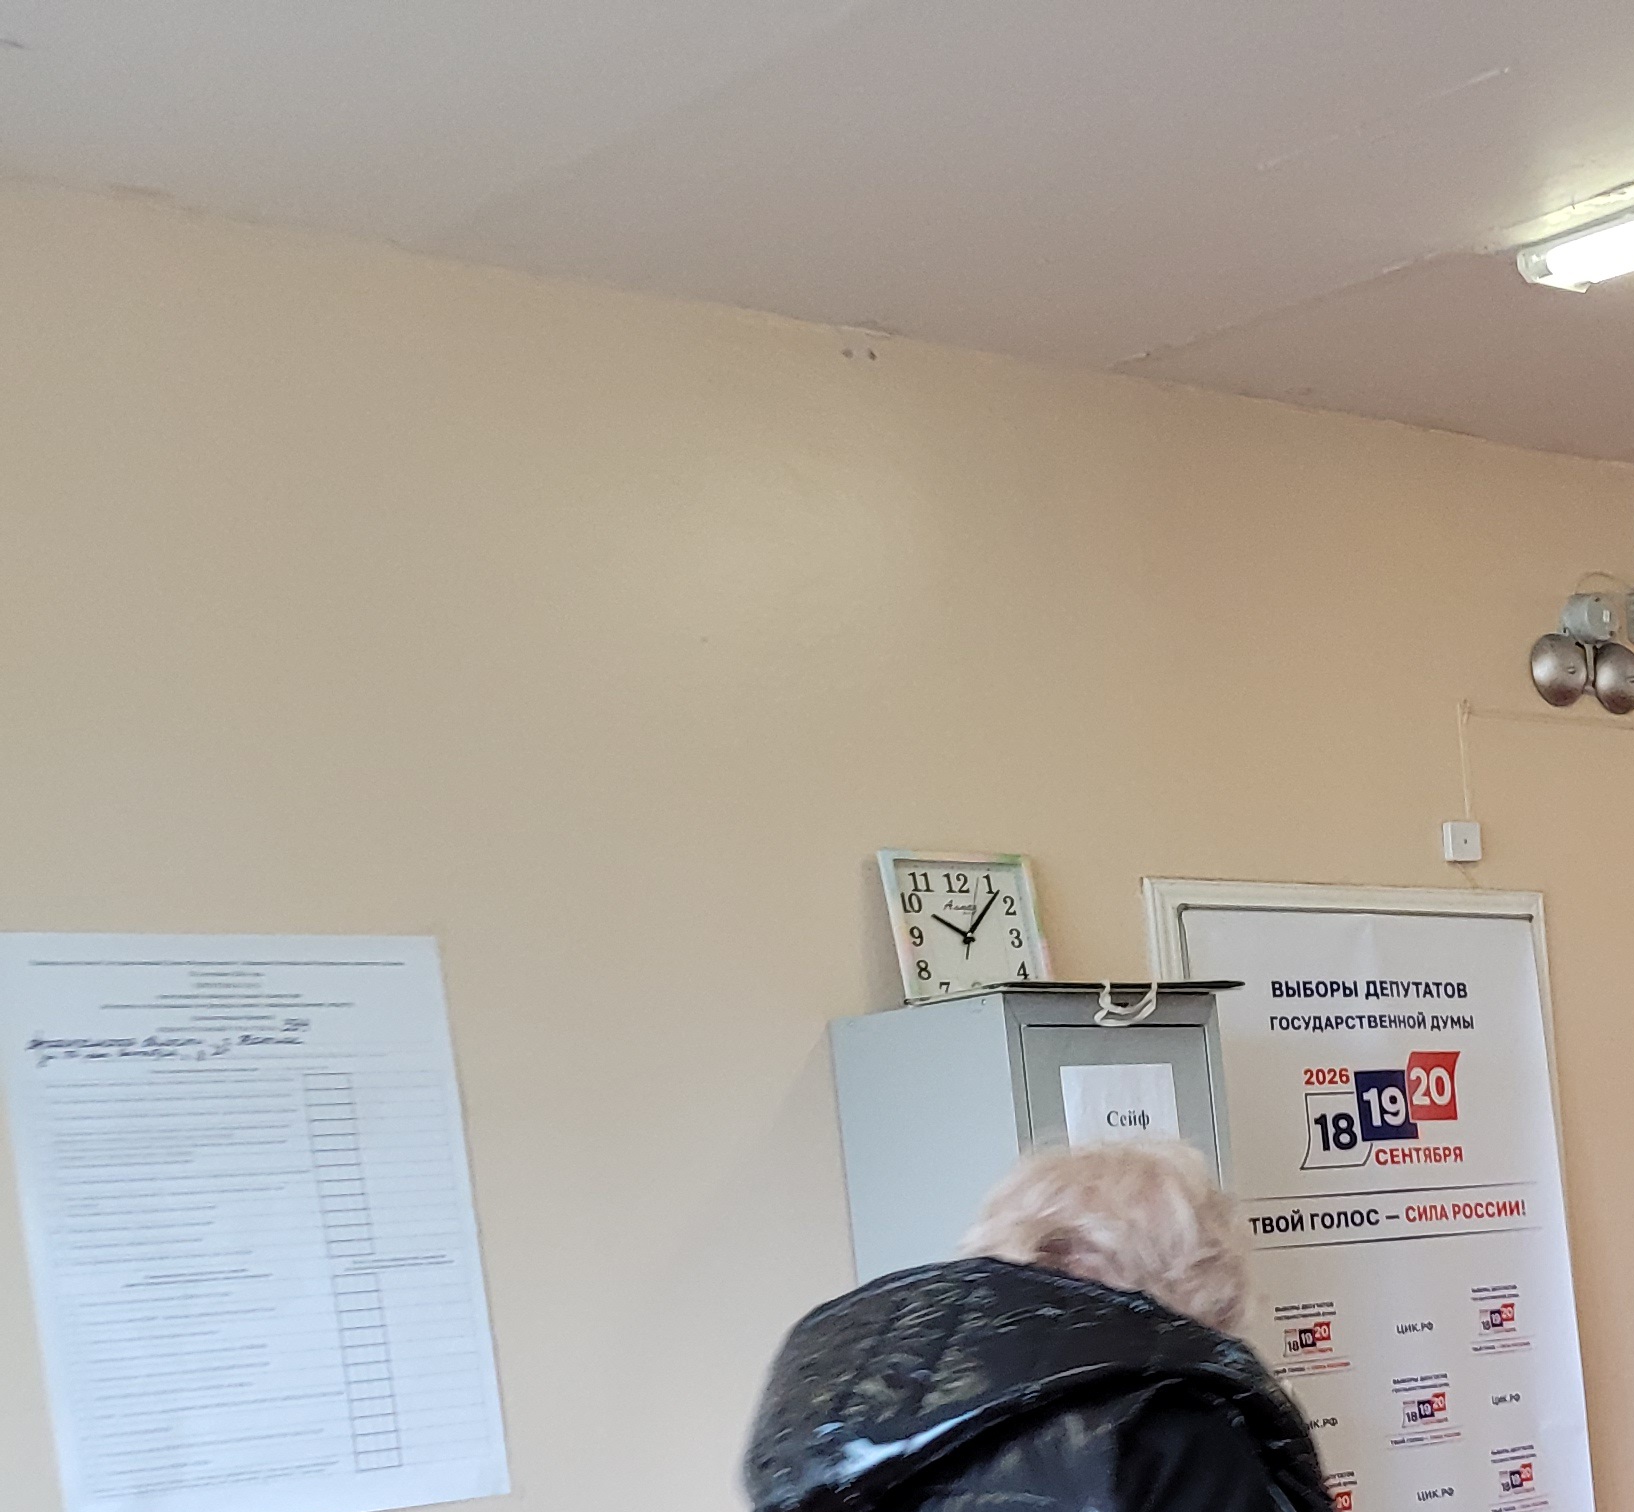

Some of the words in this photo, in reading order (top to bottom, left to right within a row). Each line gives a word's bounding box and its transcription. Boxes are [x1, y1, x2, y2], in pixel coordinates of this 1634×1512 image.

[908, 871, 934, 892] 11
[943, 873, 970, 893] 12
[983, 874, 995, 894] 1
[900, 892, 922, 913] 10
[1003, 895, 1017, 916] 2
[909, 926, 924, 947] 9
[1009, 928, 1023, 948] 3
[916, 959, 932, 980] 8
[1017, 961, 1029, 980] 4
[1271, 980, 1358, 998] ВЫБОРЫ
[1365, 979, 1468, 1000] ДЕПУТАТОВ
[1269, 1011, 1427, 1033] ГОСУДАРСТВЕННОЙ
[1430, 1014, 1475, 1032] ДУМЫ
[1303, 1067, 1350, 1086] 2026
[1313, 1112, 1358, 1151] 18
[1362, 1086, 1406, 1127] 19
[1410, 1066, 1452, 1106] 20
[1106, 1109, 1150, 1130] Сейф
[1374, 1146, 1464, 1166] СЕНТЯБРЯ
[1250, 1208, 1304, 1236] ТВОЙ
[1310, 1208, 1381, 1231] ГОЛОС
[1404, 1204, 1449, 1223] СИЛА
[1452, 1199, 1527, 1220] РОССИИ!
